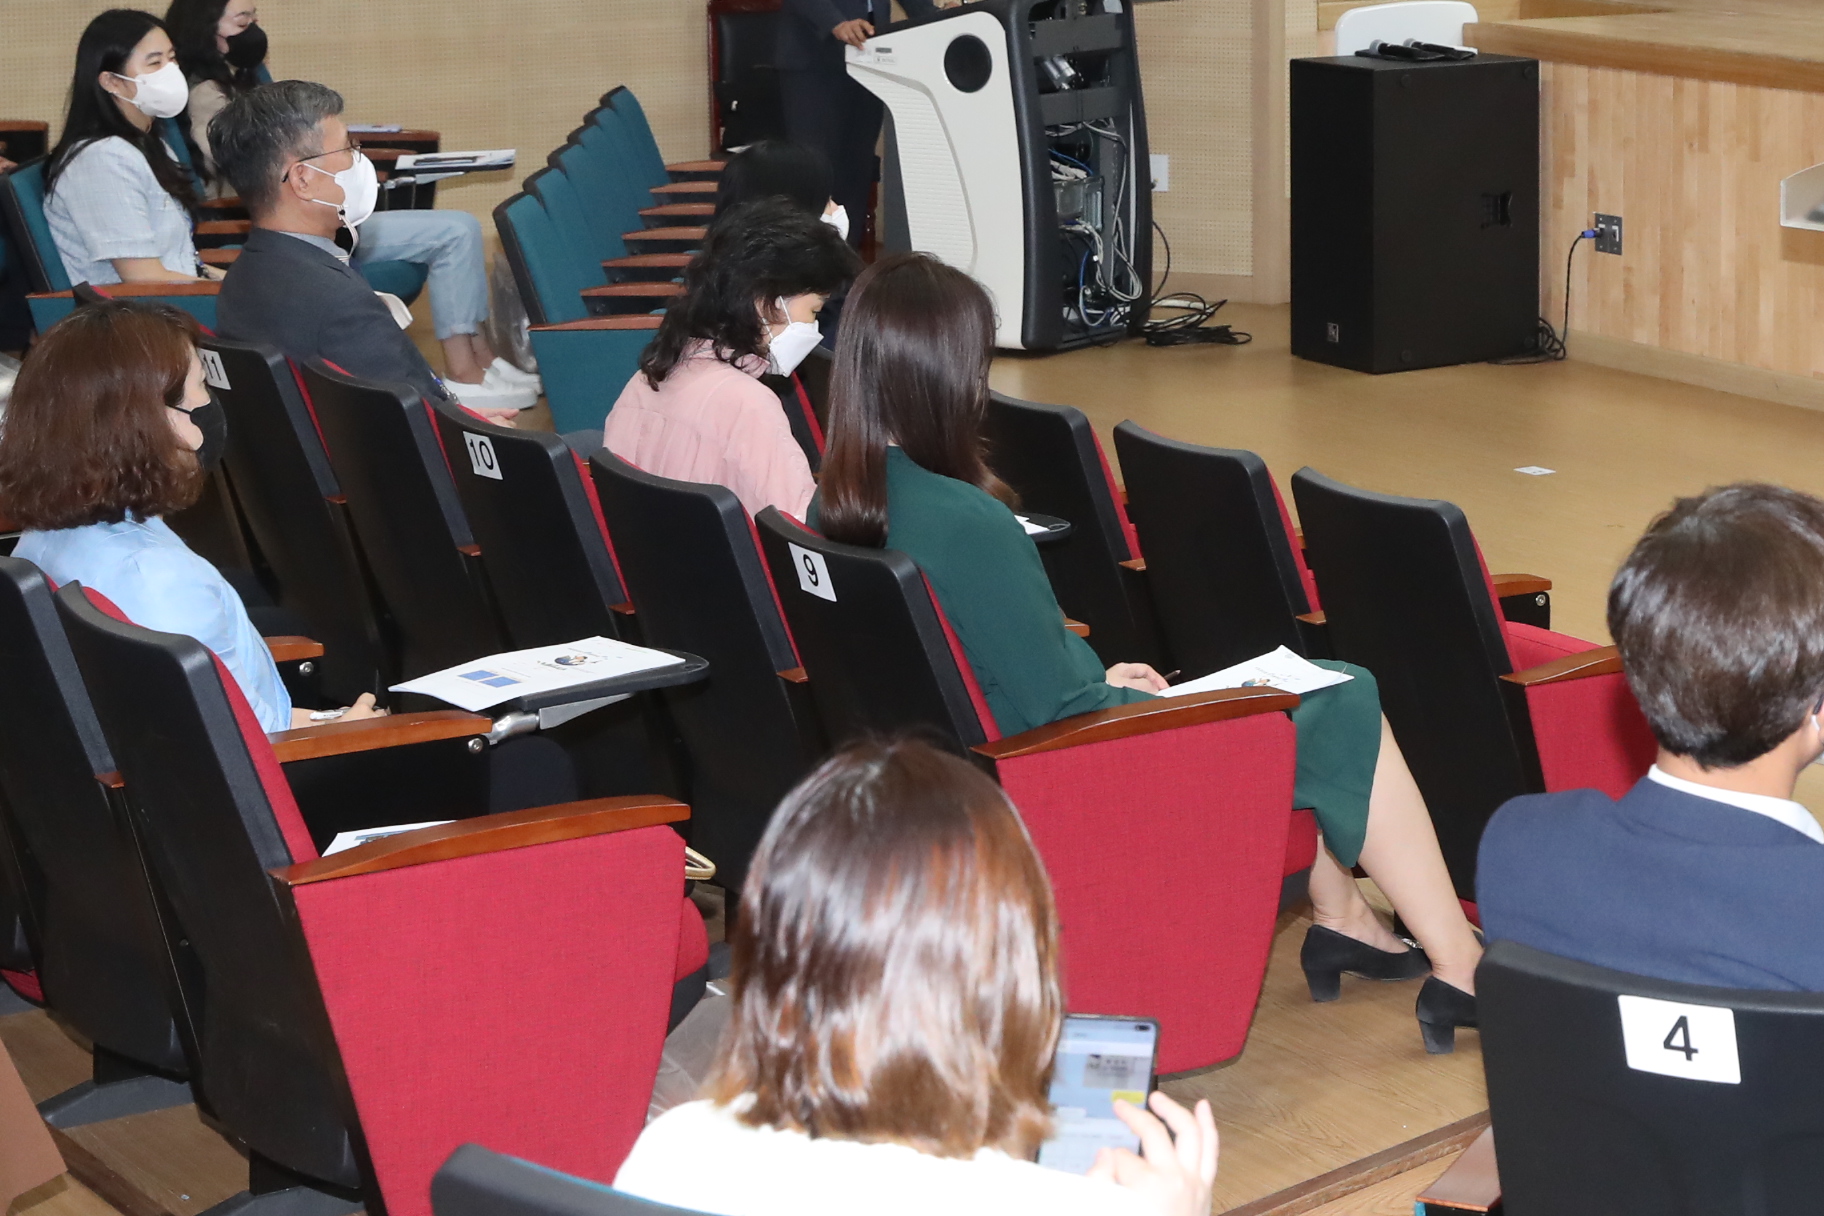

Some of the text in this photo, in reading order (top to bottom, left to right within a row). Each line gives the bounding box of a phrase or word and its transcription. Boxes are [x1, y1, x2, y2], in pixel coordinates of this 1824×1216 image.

[202, 353, 222, 382] 11
[469, 438, 494, 471] 10
[803, 553, 819, 587] 9
[1663, 1015, 1699, 1062] 4
